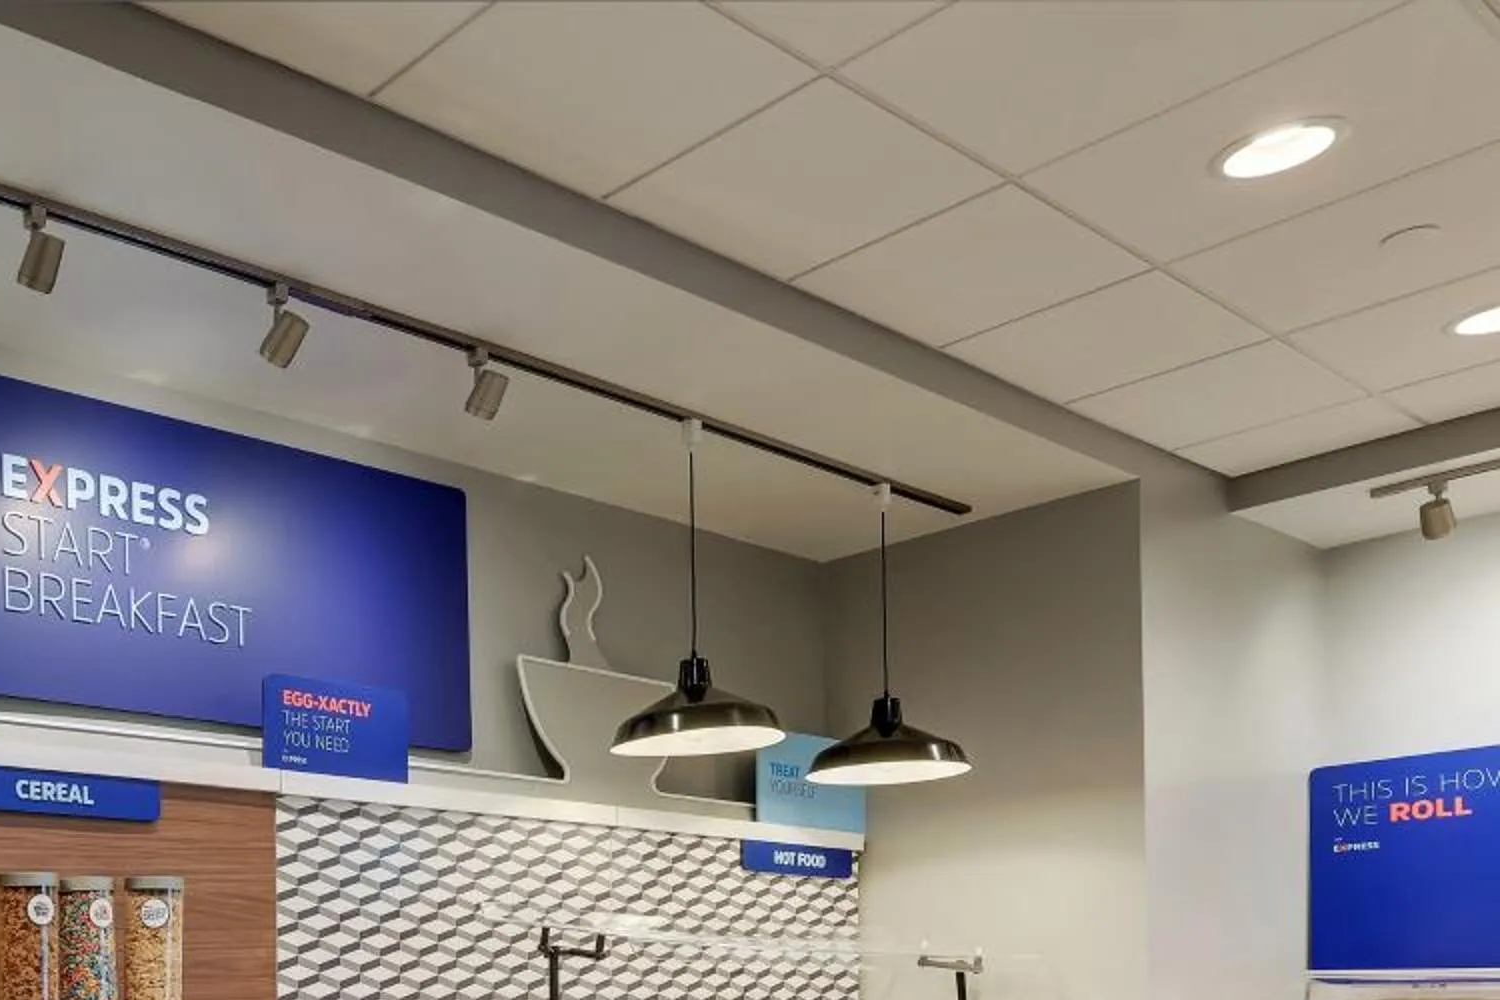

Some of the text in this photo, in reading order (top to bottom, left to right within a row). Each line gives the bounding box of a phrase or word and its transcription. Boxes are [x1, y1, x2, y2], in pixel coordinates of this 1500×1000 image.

[2, 453, 210, 535] EXPRESS
[3, 567, 252, 648] BREAKFAST
[282, 689, 372, 717] EGG-XACTLY
[281, 709, 351, 734] THE START
[283, 731, 350, 753] YOU NEED
[769, 762, 800, 778] TREAT
[15, 778, 95, 806] CEREAL
[770, 779, 818, 799] YOURSELF
[1332, 779, 1393, 803] THIS
[1405, 775, 1429, 797] IS
[1333, 795, 1473, 827] WE ROLL
[774, 851, 827, 869] HOT FOOD
[1333, 841, 1380, 853] EXPRESS
